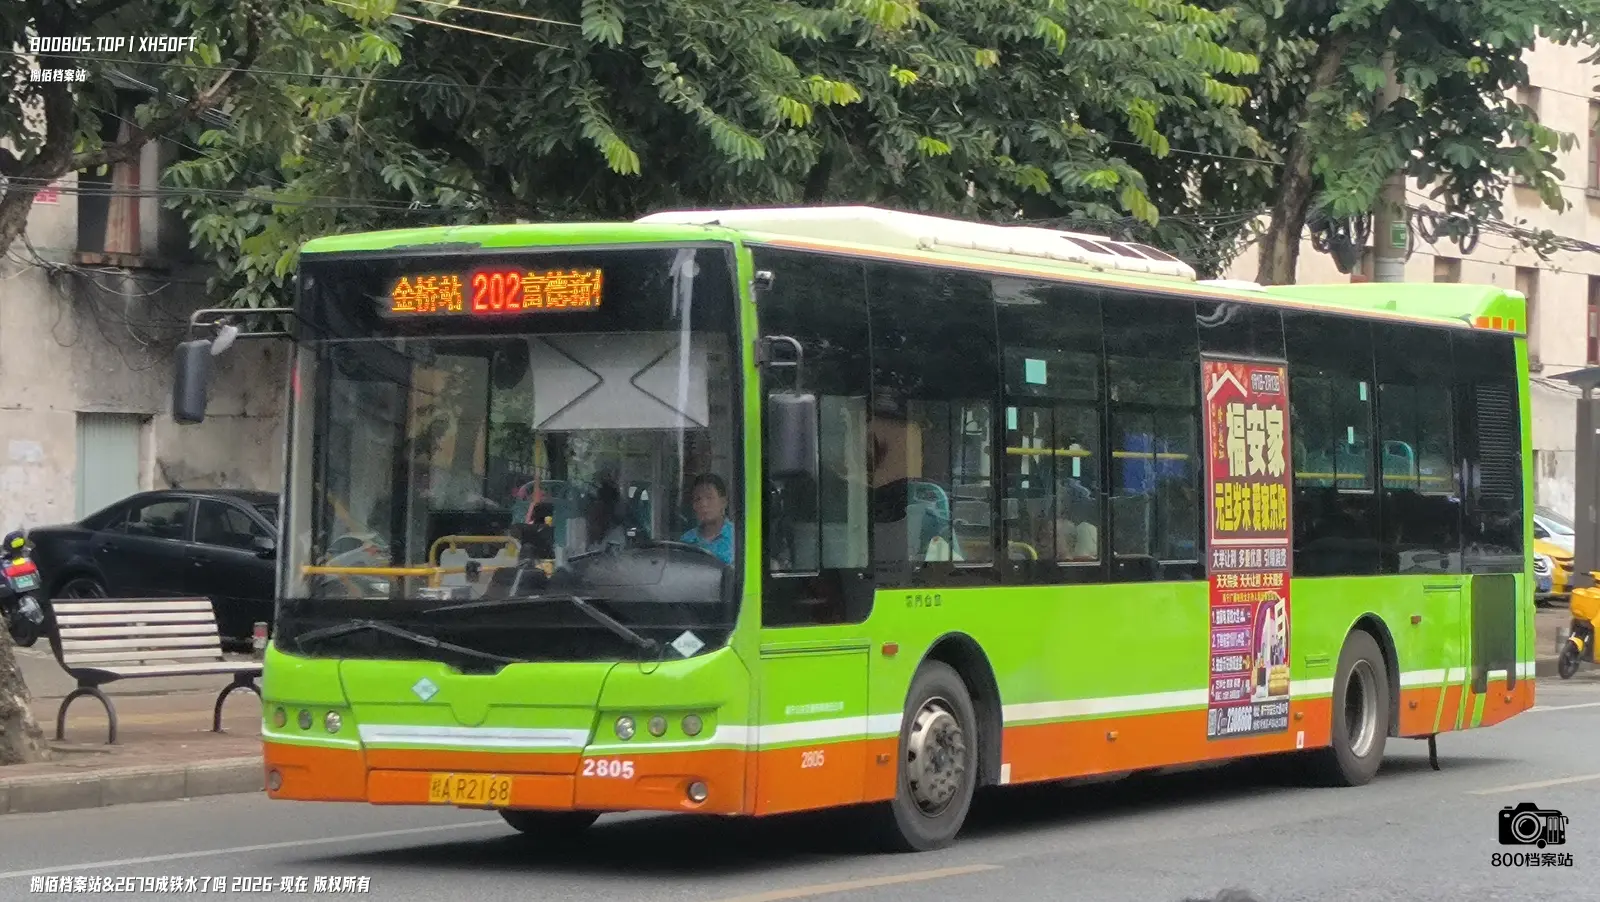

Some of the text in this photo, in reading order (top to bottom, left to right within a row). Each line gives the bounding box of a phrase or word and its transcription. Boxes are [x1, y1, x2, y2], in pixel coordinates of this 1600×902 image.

[391, 274, 463, 312] 金桥站
[472, 271, 521, 312] 202
[1226, 402, 1286, 478] 福安家
[1215, 481, 1251, 532] 元旦岁末
[582, 758, 635, 779] 2805
[801, 750, 825, 769] 2805
